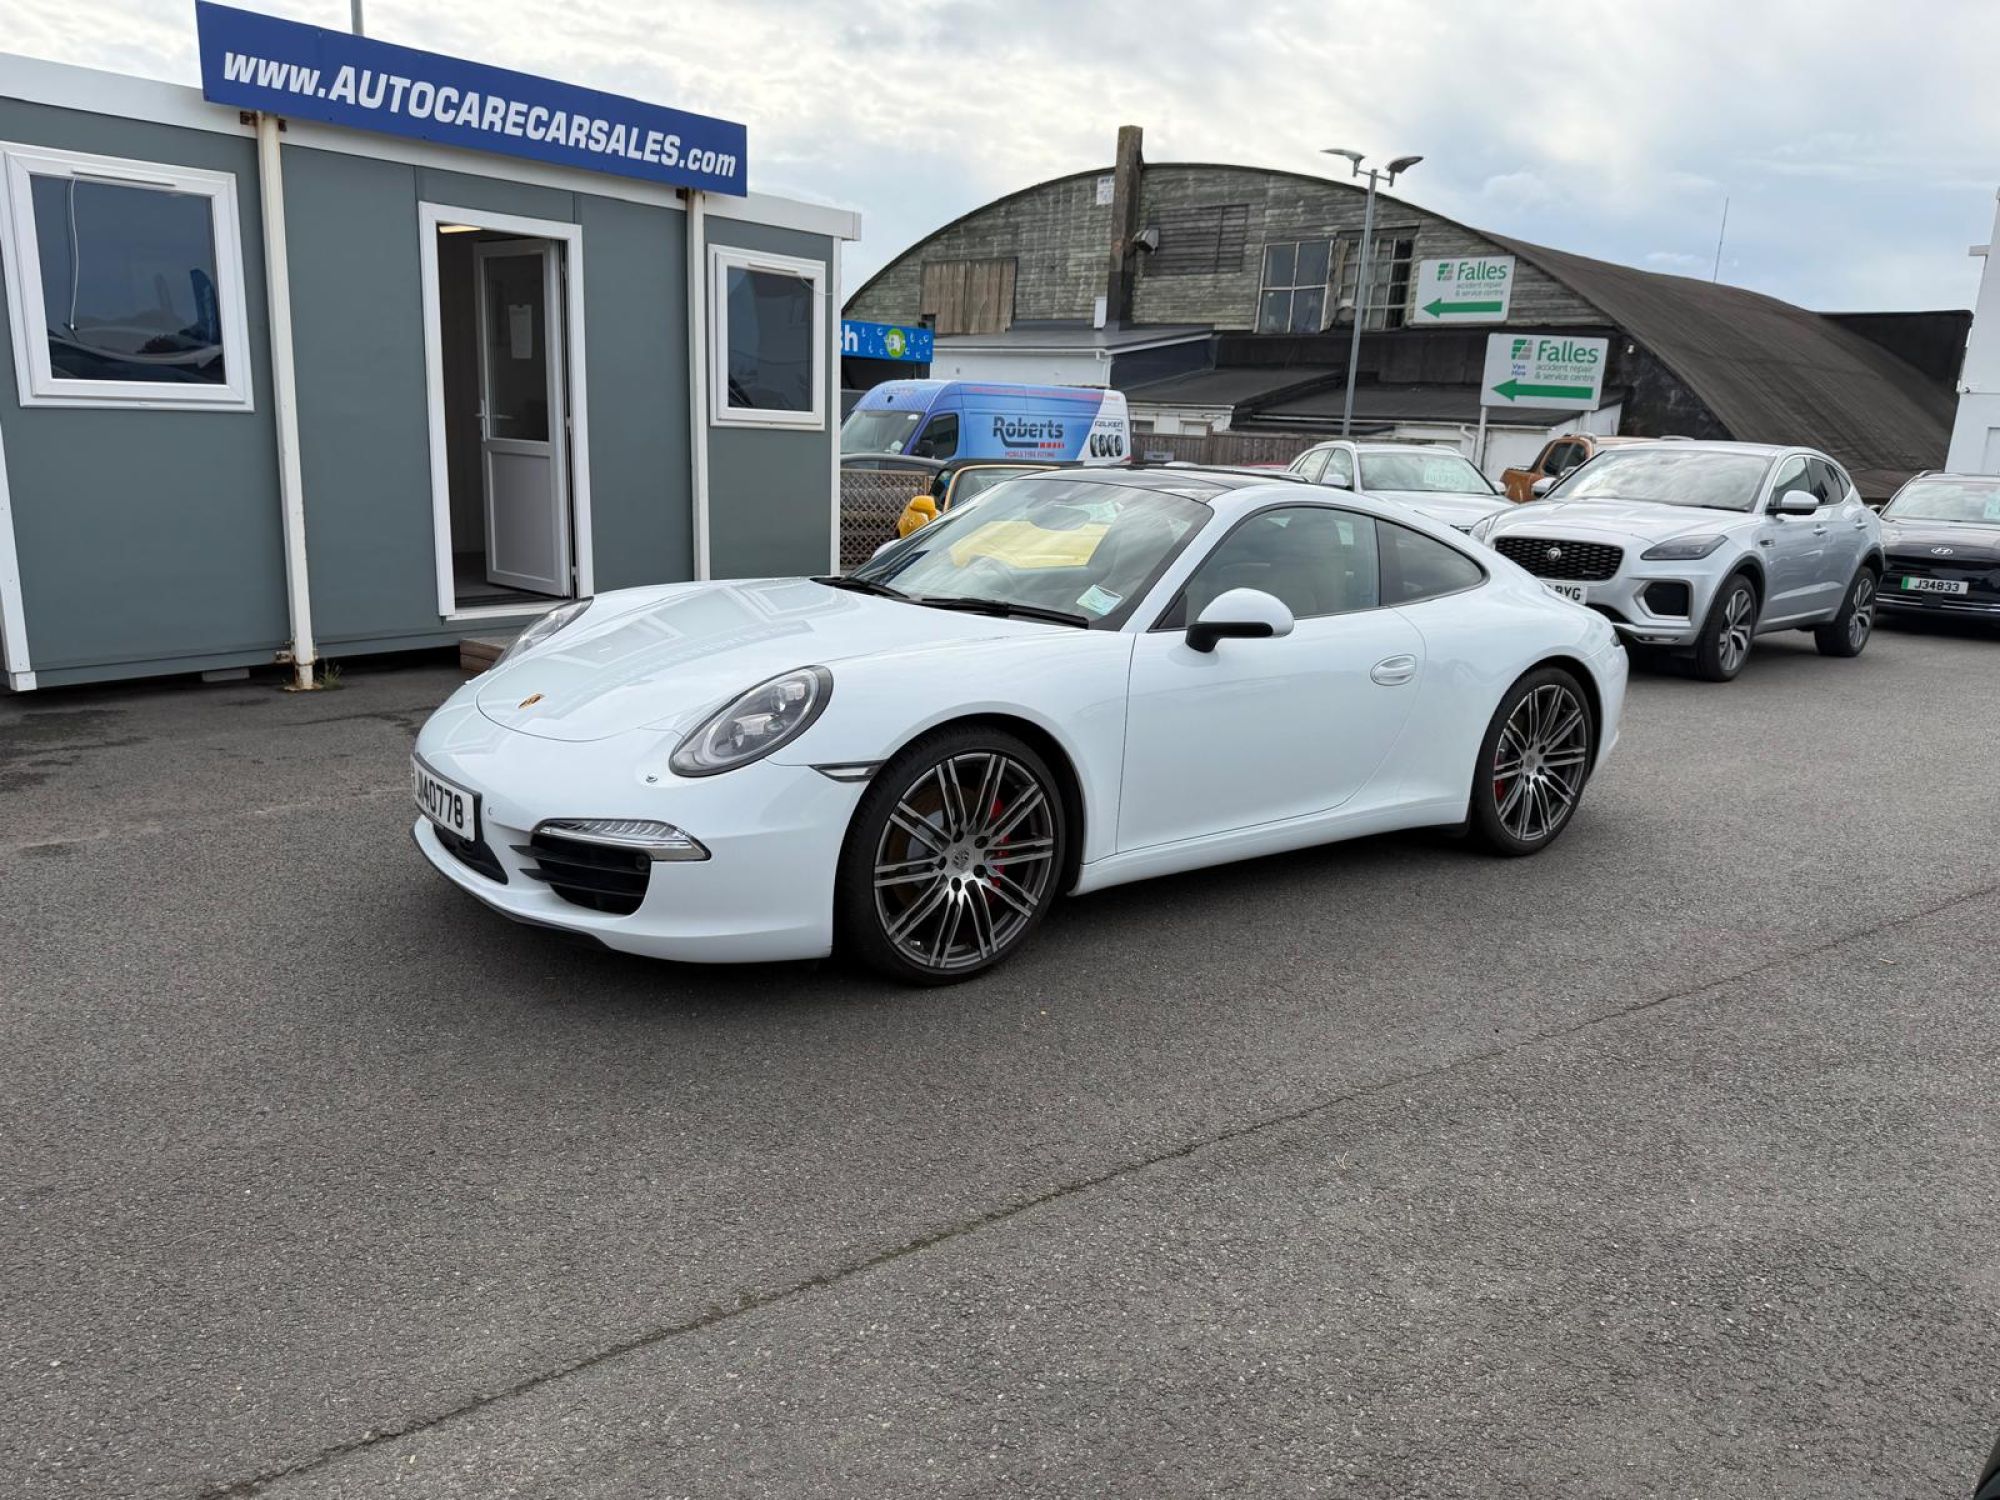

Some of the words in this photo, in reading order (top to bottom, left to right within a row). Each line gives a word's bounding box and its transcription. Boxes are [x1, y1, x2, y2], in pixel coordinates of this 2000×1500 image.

[223, 51, 737, 178] www.AUTOCARECARSALES.com
[1457, 261, 1507, 280] Falles
[1537, 340, 1599, 363] Falles
[1570, 365, 1593, 373] repair
[1570, 374, 1595, 382] centre
[993, 416, 1064, 438] Roberts
